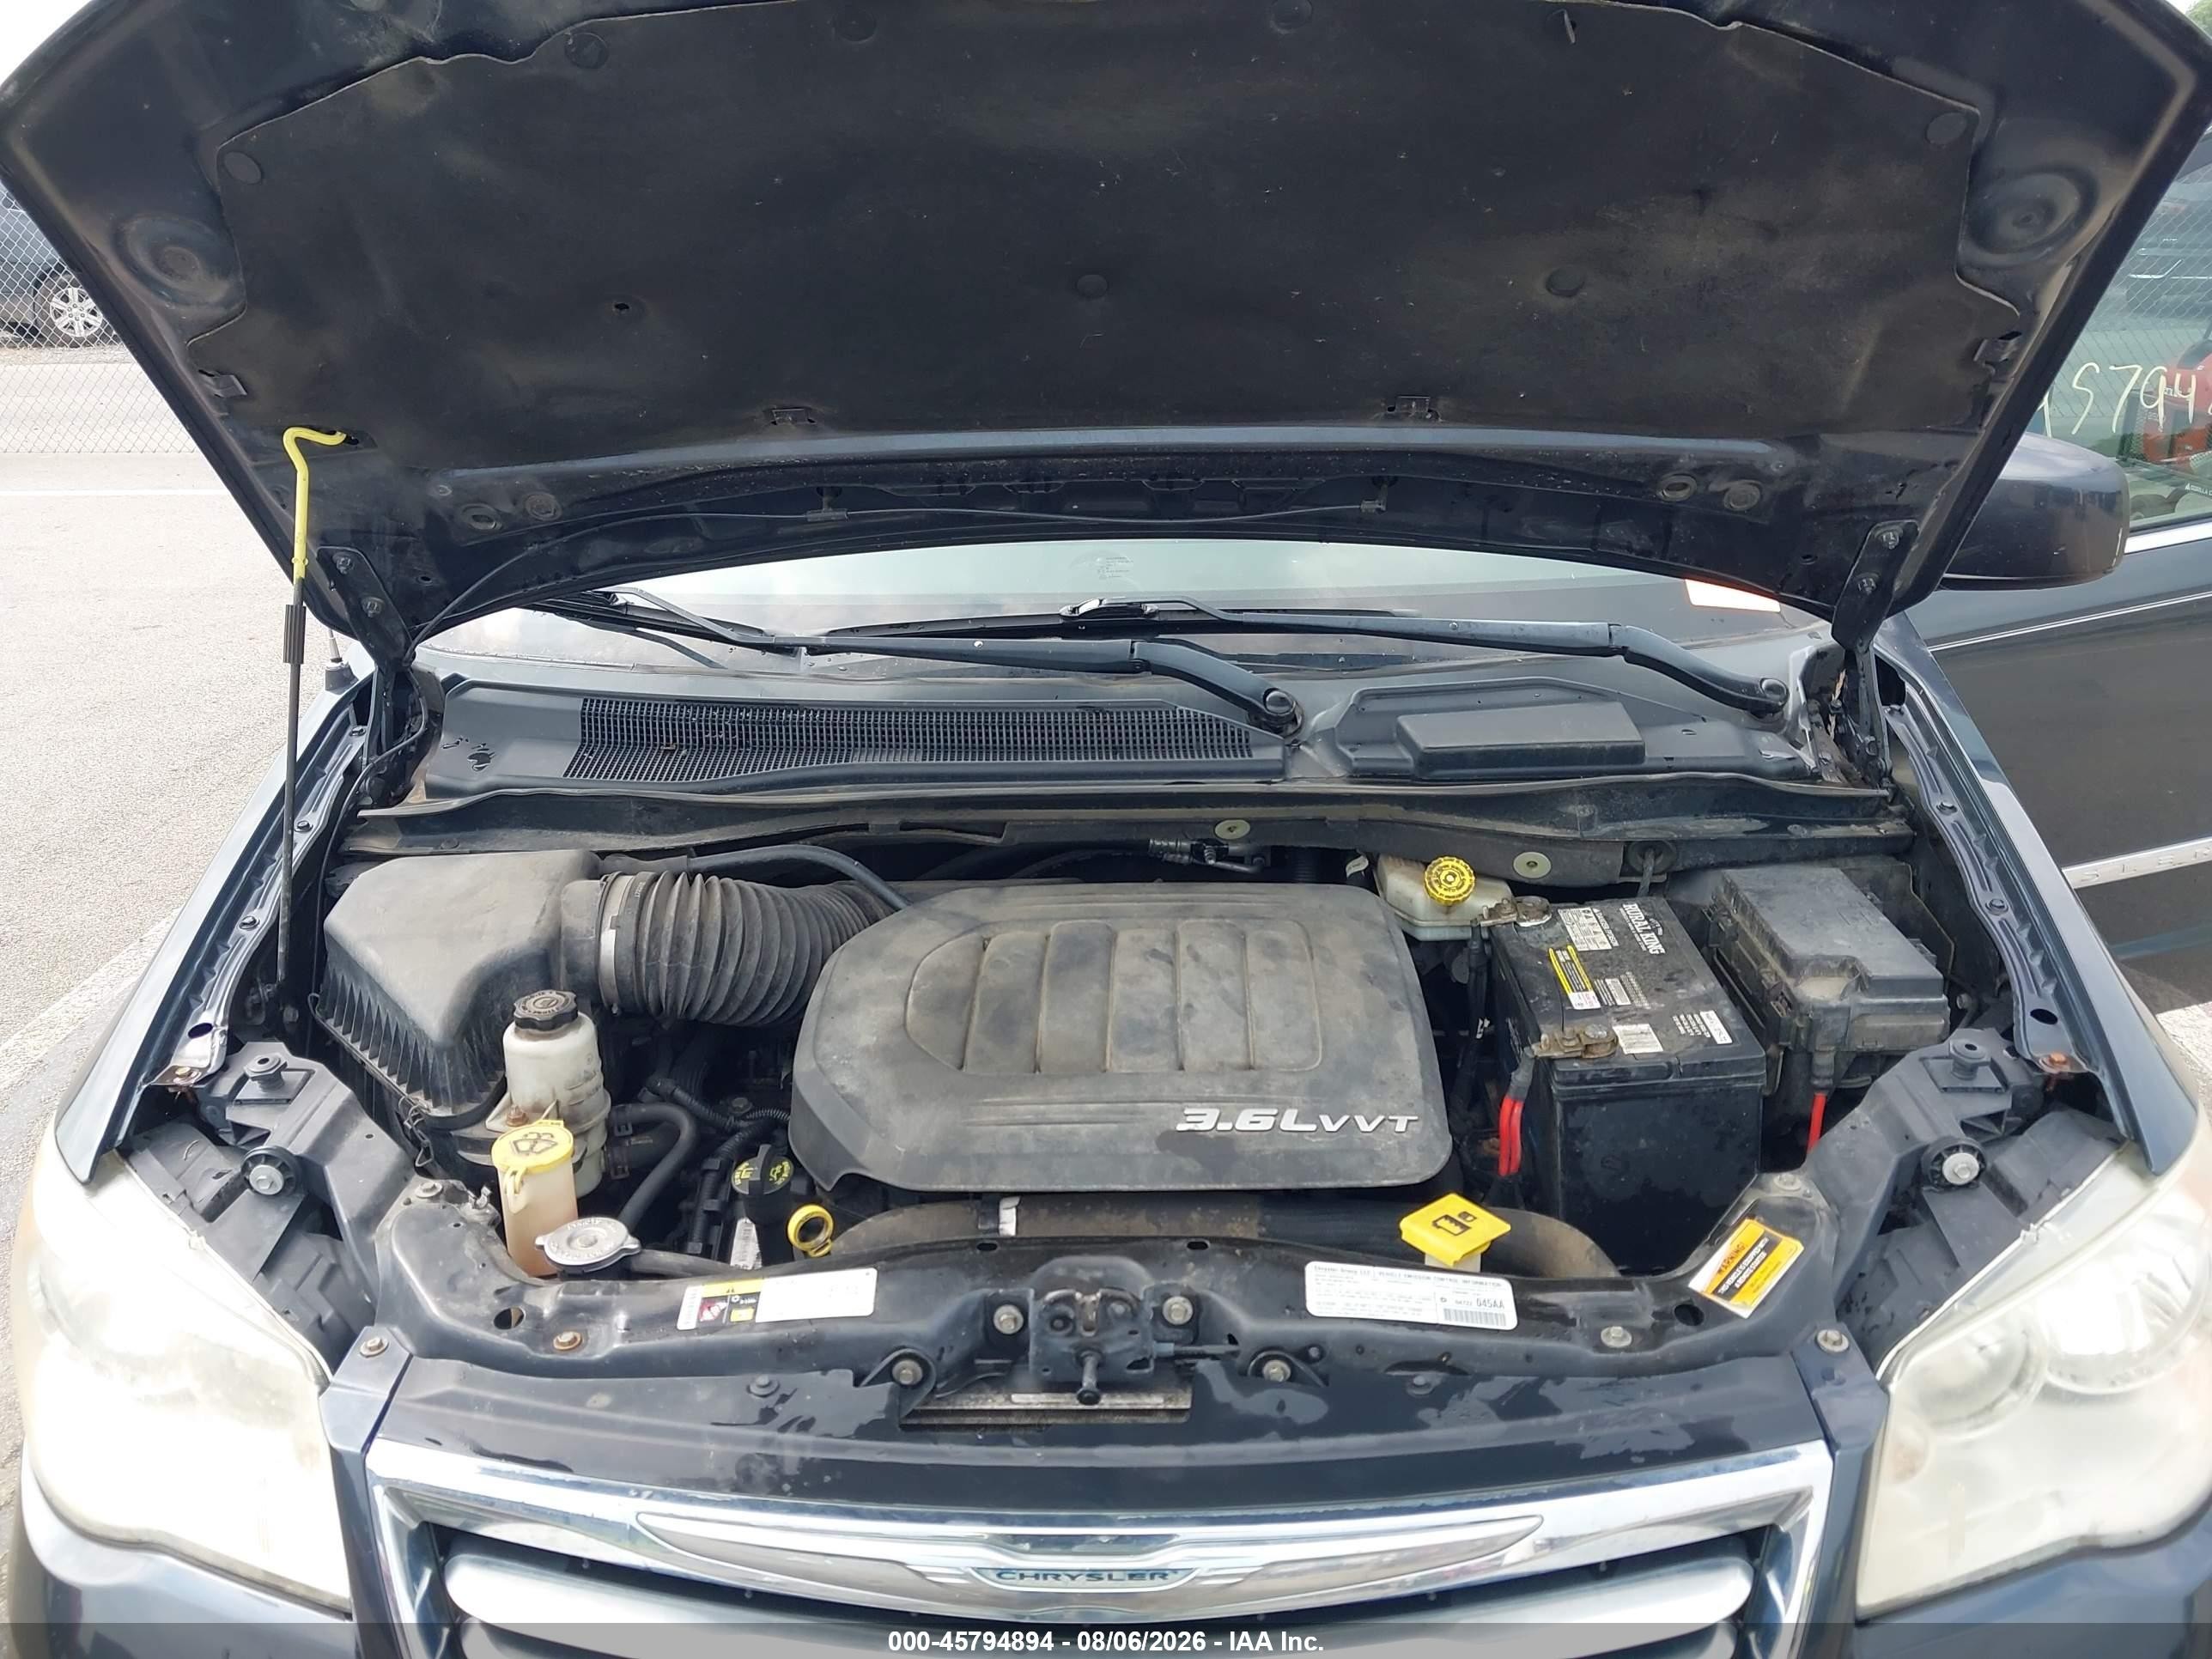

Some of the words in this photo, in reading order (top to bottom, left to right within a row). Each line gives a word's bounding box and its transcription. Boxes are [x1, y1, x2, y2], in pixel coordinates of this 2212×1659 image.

[1623, 902, 1651, 933] RURAL
[1639, 932, 1666, 954] KING
[995, 1571, 1169, 1582] CHRYSLER
